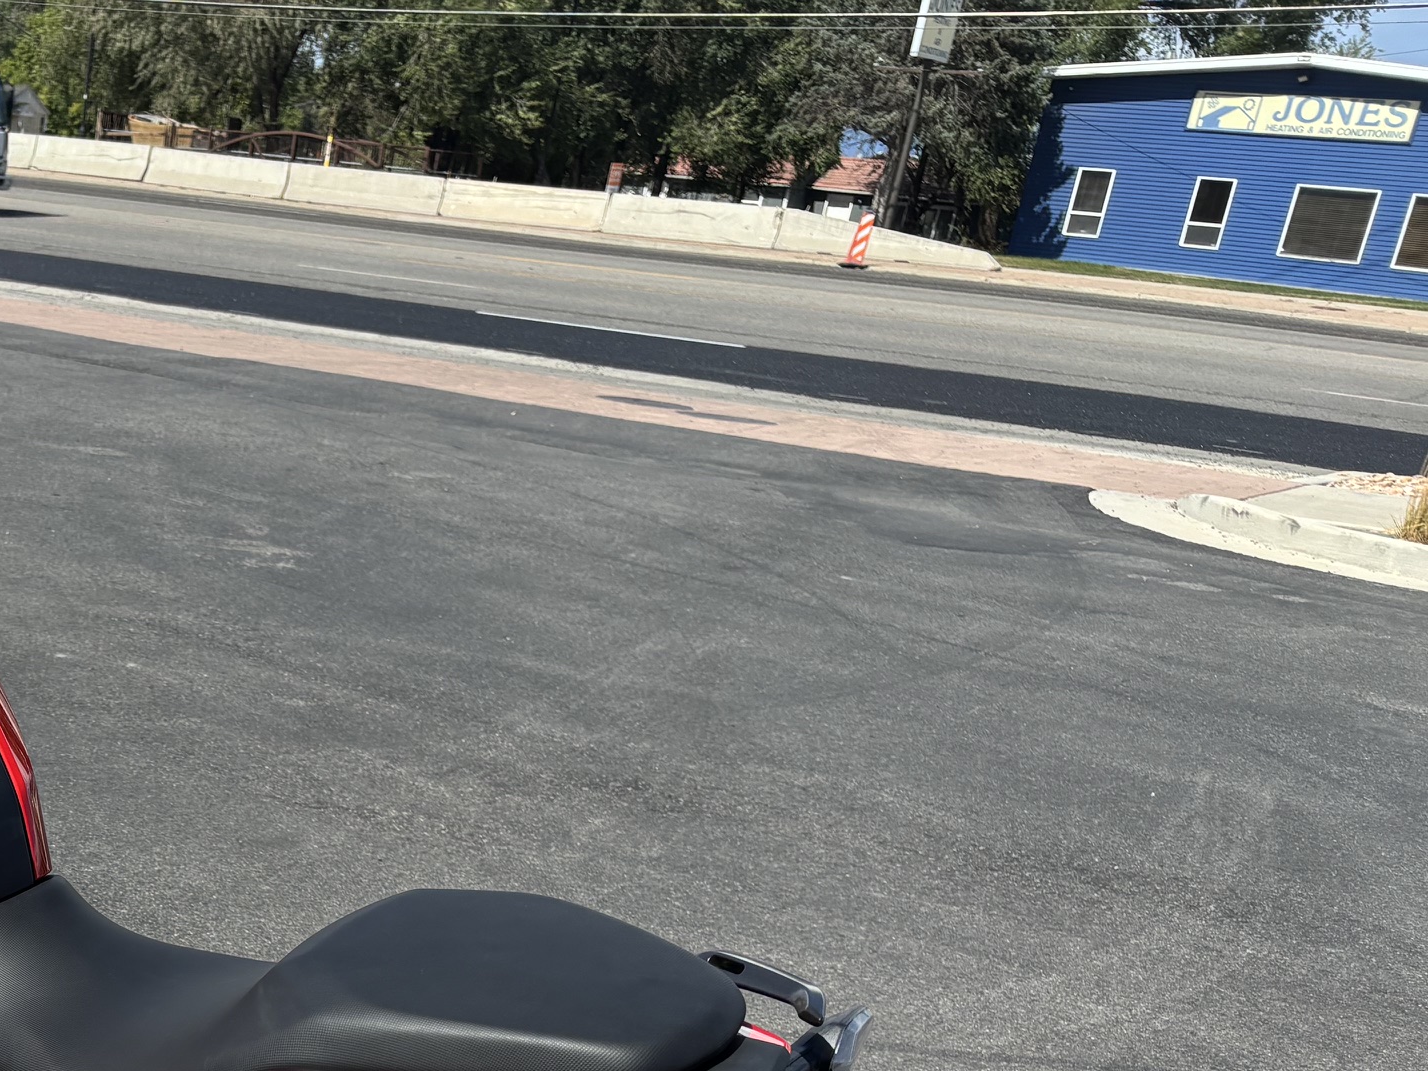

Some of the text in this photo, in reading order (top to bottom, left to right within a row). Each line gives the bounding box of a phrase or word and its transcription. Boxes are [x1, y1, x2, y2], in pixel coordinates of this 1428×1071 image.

[1272, 96, 1411, 128] JONES
[1265, 124, 1304, 133] HEATING
[1318, 127, 1333, 135] AIR
[1336, 128, 1406, 139] CONDITIONING
